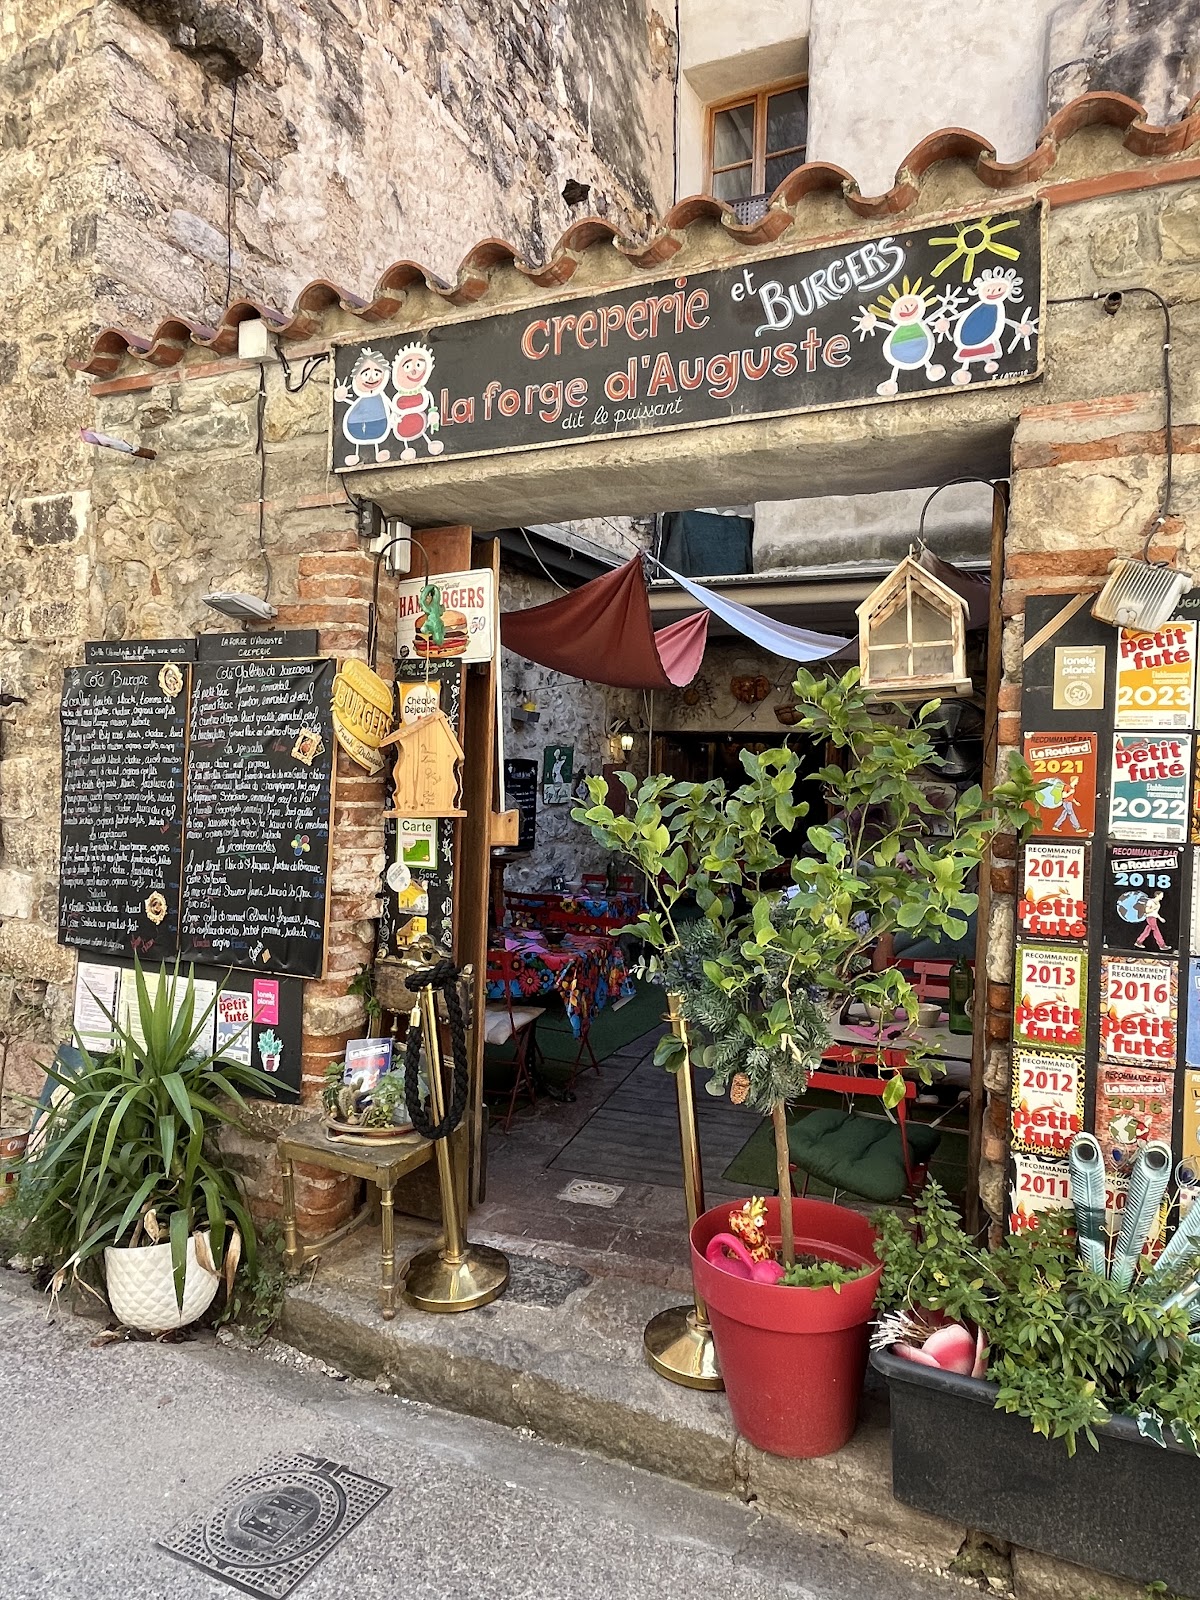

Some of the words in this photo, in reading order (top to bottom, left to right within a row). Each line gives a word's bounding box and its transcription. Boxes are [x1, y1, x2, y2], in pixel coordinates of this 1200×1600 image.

[731, 269, 757, 302] et
[755, 236, 906, 338] BURGERS
[483, 377, 588, 423] forge
[604, 327, 851, 402] d'Auguste
[561, 413, 585, 430] dit
[590, 405, 609, 425] le
[613, 396, 684, 433] puissant
[1119, 628, 1188, 659] petit
[1063, 655, 1096, 667] lonely
[1133, 645, 1191, 671] futé
[110, 669, 149, 693] Burger
[1061, 665, 1097, 676] planet
[1070, 687, 1087, 700] 50
[1117, 685, 1192, 706] 2023
[1031, 749, 1045, 759] Le
[1044, 742, 1089, 758] Routard
[1115, 740, 1182, 769] petit
[1032, 759, 1084, 774] 2021
[1128, 760, 1185, 782] futé
[1112, 796, 1186, 820] 2022
[402, 820, 432, 833] Carte
[1027, 846, 1082, 855] RECOMMANDÉ
[1028, 858, 1080, 879] 2014
[1114, 861, 1128, 871] Le
[1128, 857, 1176, 870] Routard
[1113, 871, 1172, 889] 2018
[1017, 898, 1088, 920] petit
[1028, 914, 1087, 938] futé
[1025, 952, 1079, 963] RECOMMANDÉ
[1025, 963, 1077, 987] 2013
[1111, 971, 1168, 981] RECOMMANDÉ
[1109, 979, 1169, 1004] 2016
[219, 997, 248, 1014] petit
[224, 1009, 250, 1023] futé
[1015, 1004, 1084, 1027] petit
[1025, 1020, 1083, 1046] futé
[1101, 1016, 1175, 1039] petit
[1112, 1033, 1175, 1059] futé
[1022, 1057, 1076, 1069] RECOMMANDÉ
[1022, 1069, 1074, 1093] 2012
[1106, 1084, 1120, 1093] Le
[1119, 1083, 1163, 1094] Routard
[1107, 1096, 1163, 1115] 2016
[1013, 1110, 1083, 1133] petit
[1020, 1173, 1070, 1199] 2011
